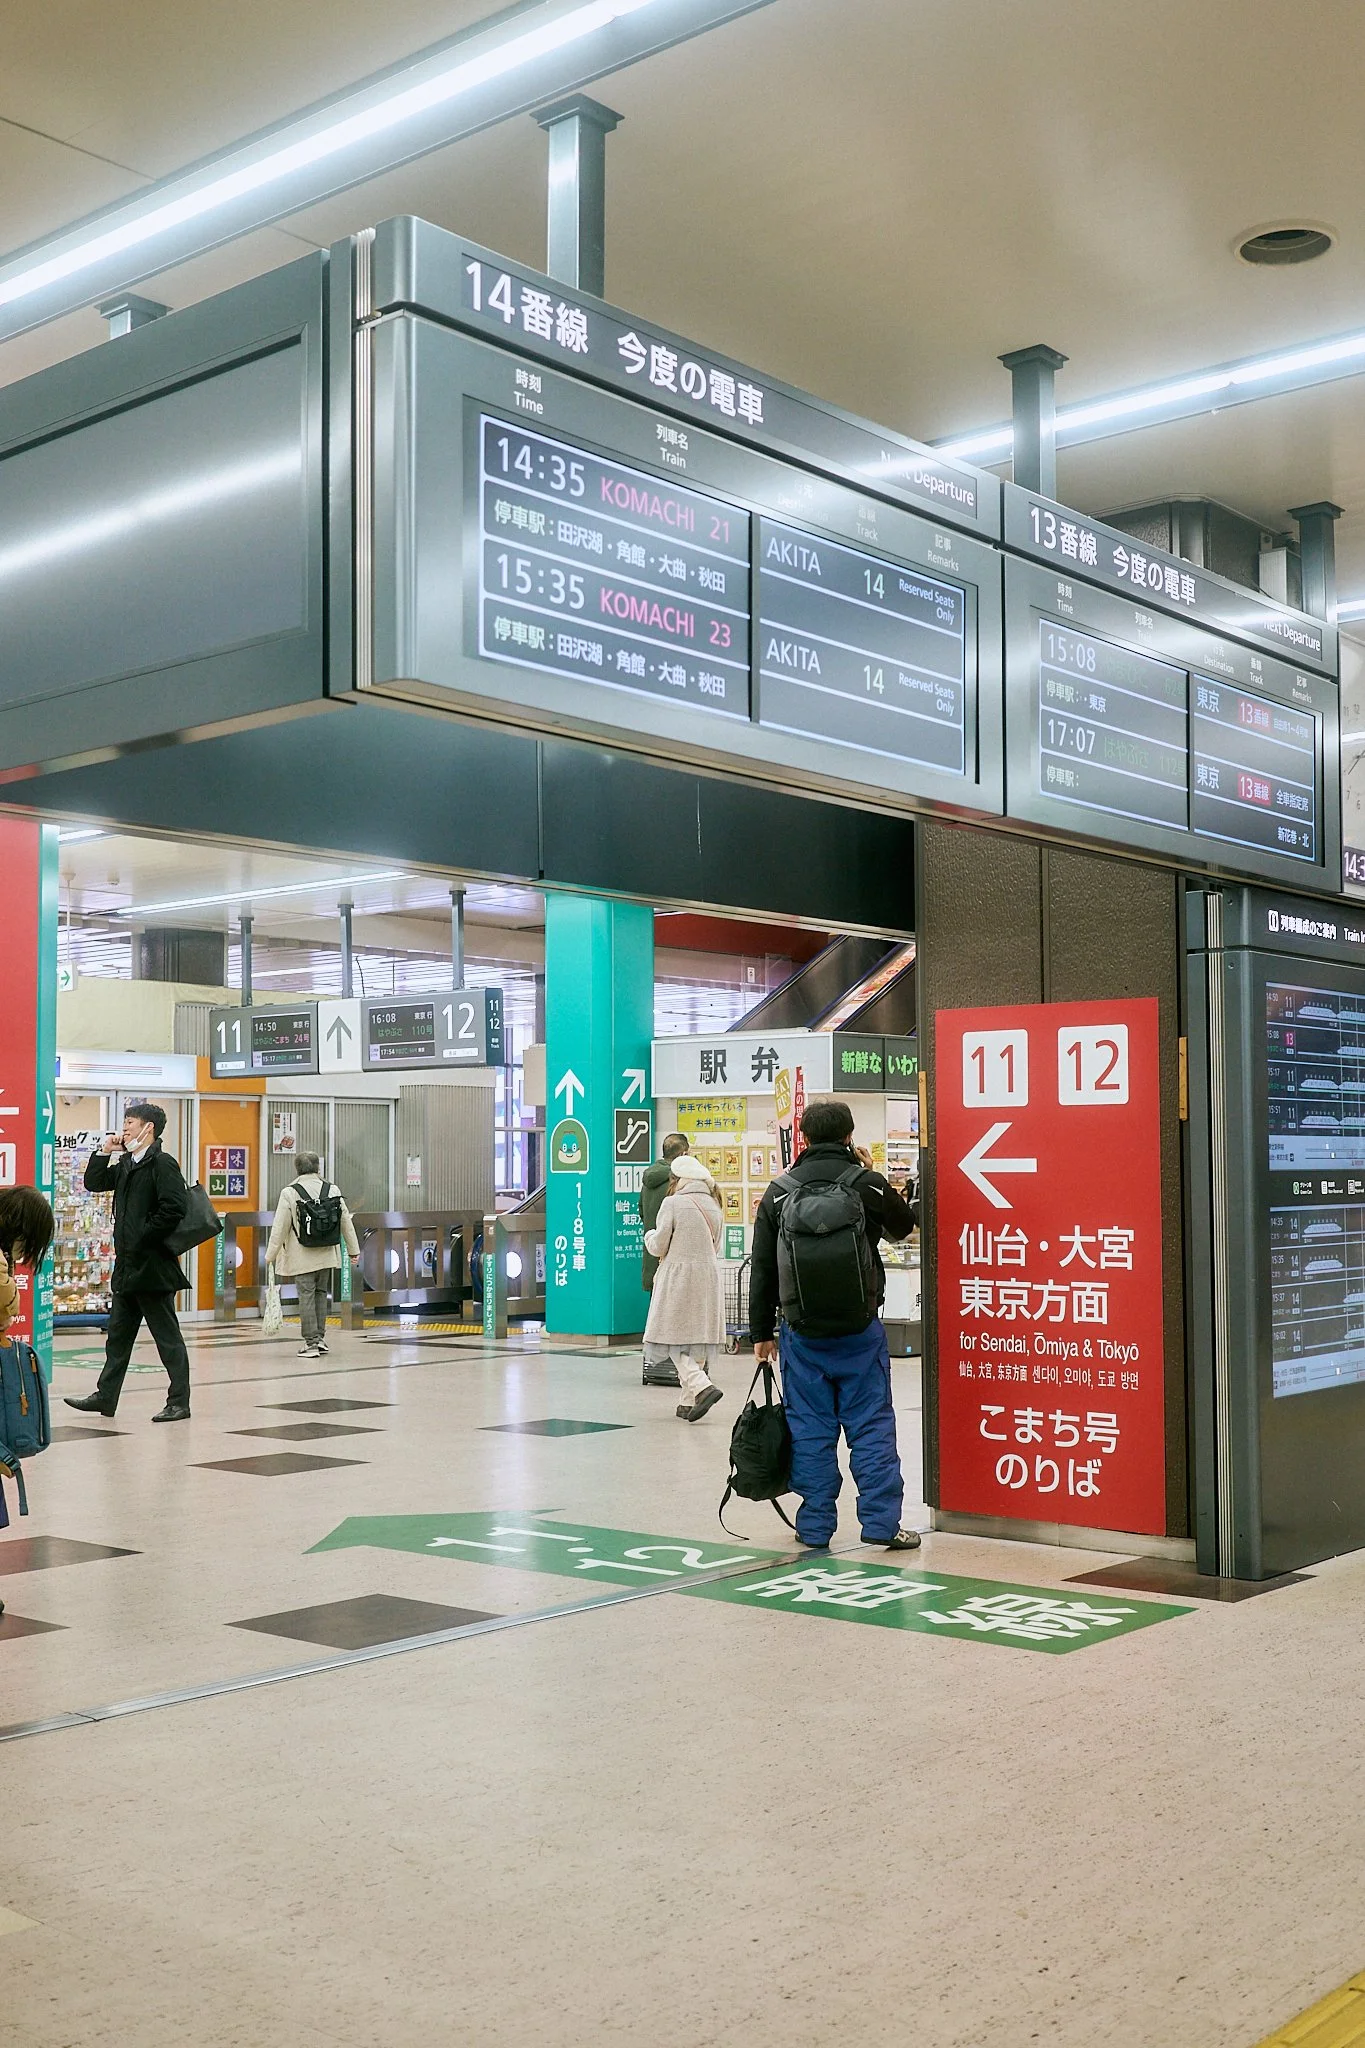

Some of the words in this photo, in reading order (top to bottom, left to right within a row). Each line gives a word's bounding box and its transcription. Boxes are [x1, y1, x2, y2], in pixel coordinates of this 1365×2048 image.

[465, 261, 589, 355] 14番線
[616, 331, 765, 426] 今度の電車
[515, 368, 542, 394] 時刻
[514, 391, 544, 415] Time
[656, 423, 689, 451] 列車名
[497, 437, 585, 497] 14:35
[660, 447, 686, 469] Train
[913, 468, 975, 507] Departure
[600, 476, 695, 532] KOMACHI
[709, 516, 730, 543] 21
[857, 523, 878, 542] Track
[766, 537, 821, 575] AKITA
[927, 551, 959, 572] Remarks
[1030, 507, 1097, 566] 13番線
[1113, 545, 1196, 606] 今度の電車
[497, 553, 585, 609] 15:35
[864, 569, 885, 599] 14
[899, 578, 933, 601] Reserved
[935, 591, 955, 609] Seats
[600, 587, 695, 638] KOMACHI
[709, 620, 732, 648] 23
[936, 607, 955, 625] Only
[1057, 599, 1073, 614] Time
[1283, 622, 1321, 652] Departure
[766, 638, 821, 674] AKITA
[1048, 634, 1096, 673] 15:08
[1204, 654, 1235, 675] Destination
[864, 665, 885, 694] 14
[899, 672, 933, 693] Reserved
[935, 683, 955, 700] Seats
[1250, 671, 1263, 686] Track
[936, 699, 955, 717] Only
[1197, 686, 1220, 713] 東京
[1048, 719, 1096, 755] 17:07
[1197, 763, 1220, 790] 東京
[1343, 926, 1360, 943] Train
[372, 1013, 396, 1024] 16:08
[489, 1000, 498, 1011] 11
[255, 1022, 277, 1032] 14:50
[442, 1002, 476, 1040] 12
[489, 1019, 500, 1030] 12
[216, 1020, 241, 1054] 11
[700, 1046, 779, 1085] 駅弁
[841, 1051, 882, 1074] 新鮮な
[971, 1044, 1014, 1094] 11
[1066, 1039, 1120, 1091] 12
[617, 1171, 629, 1188] 11
[555, 1235, 568, 1287] のりば
[958, 1223, 1135, 1270] 仙台・大宮
[959, 1276, 1110, 1325] 東京方面
[960, 1331, 977, 1350] for
[980, 1331, 1030, 1357] Sendai,
[1034, 1331, 1079, 1361] Ōmiya
[1083, 1338, 1093, 1358] &
[1097, 1339, 1139, 1365] Tōkyō
[997, 1363, 1028, 1382] 东京方面
[1032, 1365, 1062, 1388] 센다이,
[1064, 1367, 1094, 1390] 오미야,
[1098, 1370, 1116, 1388] 도쿄
[1120, 1371, 1139, 1391] 방면
[979, 1404, 1121, 1454] こまち号
[995, 1453, 1103, 1498] のりば
